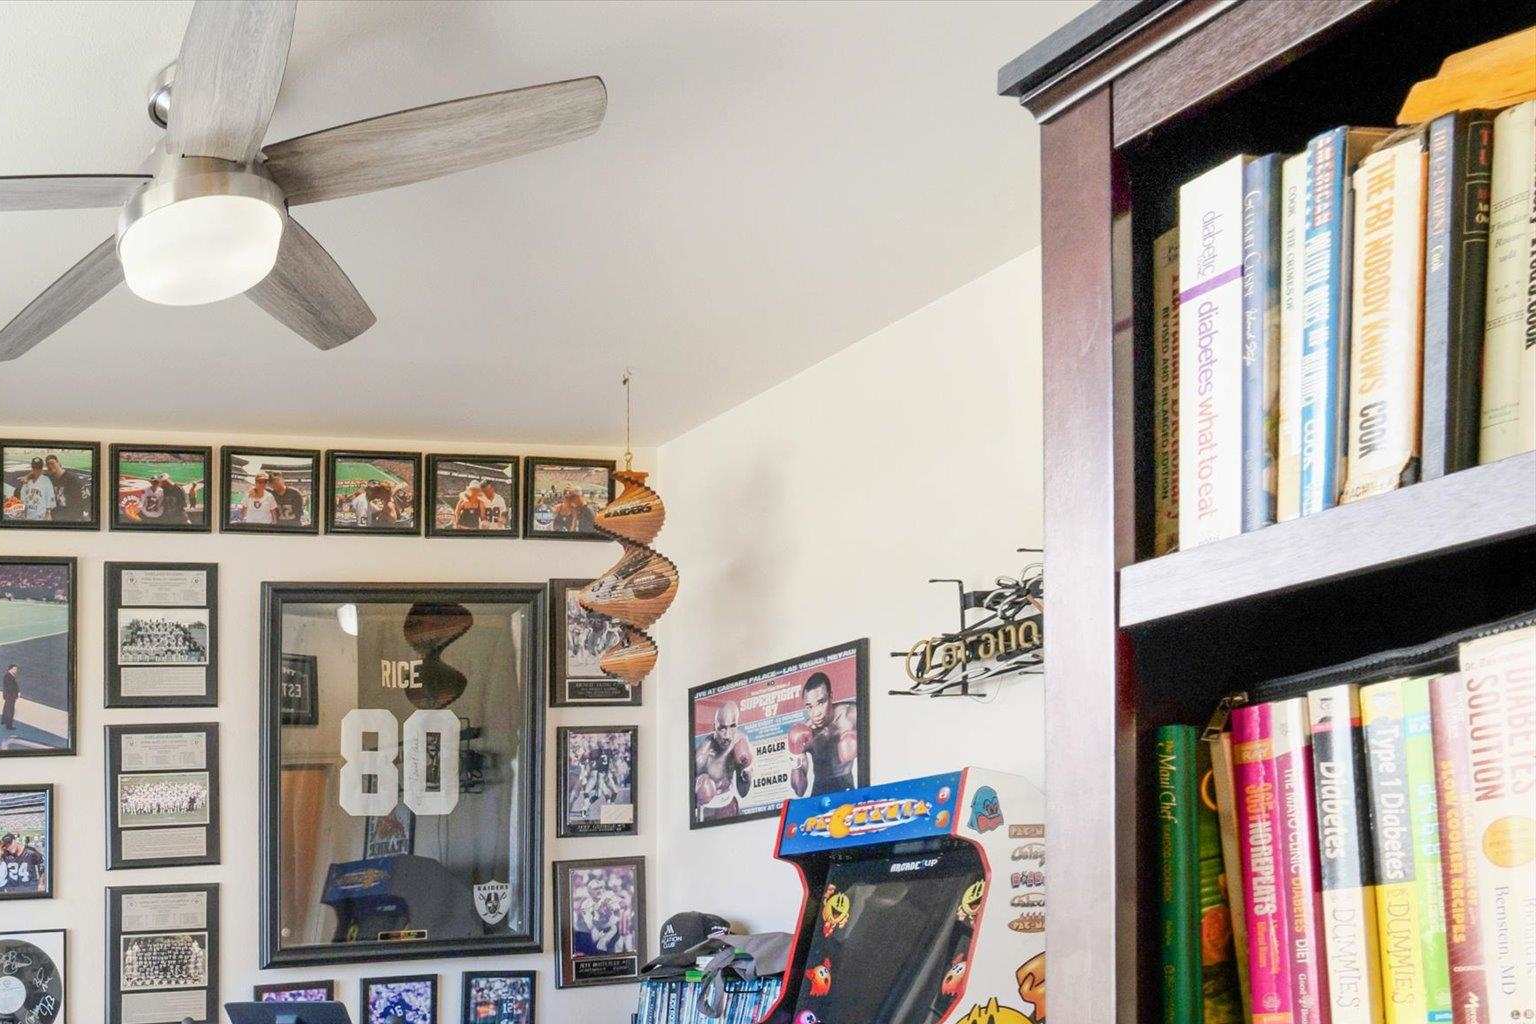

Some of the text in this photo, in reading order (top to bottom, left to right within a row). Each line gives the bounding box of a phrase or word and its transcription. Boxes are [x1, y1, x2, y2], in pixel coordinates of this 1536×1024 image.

[1359, 155, 1396, 394] THE FBI NOBODY KNOWS
[1197, 301, 1219, 521] diabetes what to eat
[1358, 400, 1386, 460] COOK
[381, 659, 423, 689] RICE
[339, 709, 461, 817] 80
[756, 741, 786, 756] HAGLER
[1376, 726, 1402, 773] Type
[1466, 677, 1505, 802] SOLUTION
[753, 773, 788, 788] LEONARD
[1159, 753, 1176, 790] Maui
[1381, 776, 1403, 787] 1
[1159, 791, 1178, 824] Chef
[1286, 792, 1300, 830] MAYO
[1320, 760, 1345, 860] Diabetes
[1289, 832, 1303, 875] CLINIC
[1382, 793, 1408, 881] Diabetes
[1291, 877, 1306, 933] DIABETES
[1295, 938, 1309, 964] DIET
[1334, 907, 1360, 1009] DUMMIES
[1387, 903, 1413, 1006] DUMMIES
[1493, 886, 1517, 996] Bernstein, MD
